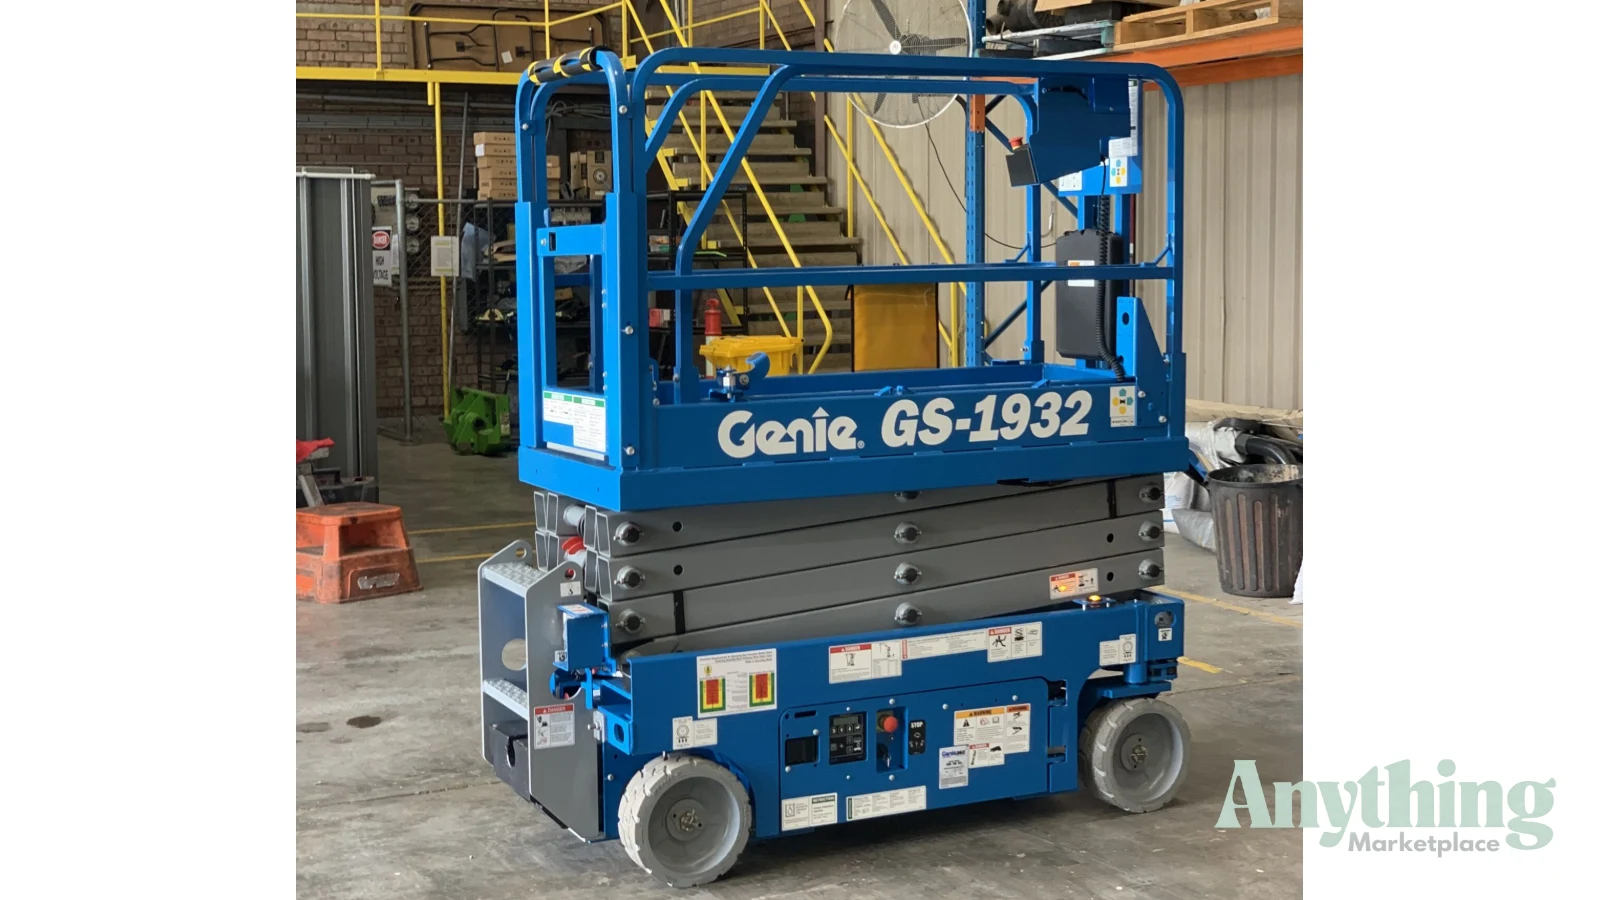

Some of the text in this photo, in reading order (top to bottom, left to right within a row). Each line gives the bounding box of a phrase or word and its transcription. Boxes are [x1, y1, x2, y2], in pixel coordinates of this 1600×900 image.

[375, 255, 385, 266] HIGH
[718, 390, 1093, 459] Genie GS-1932
[910, 721, 923, 729] STOP
